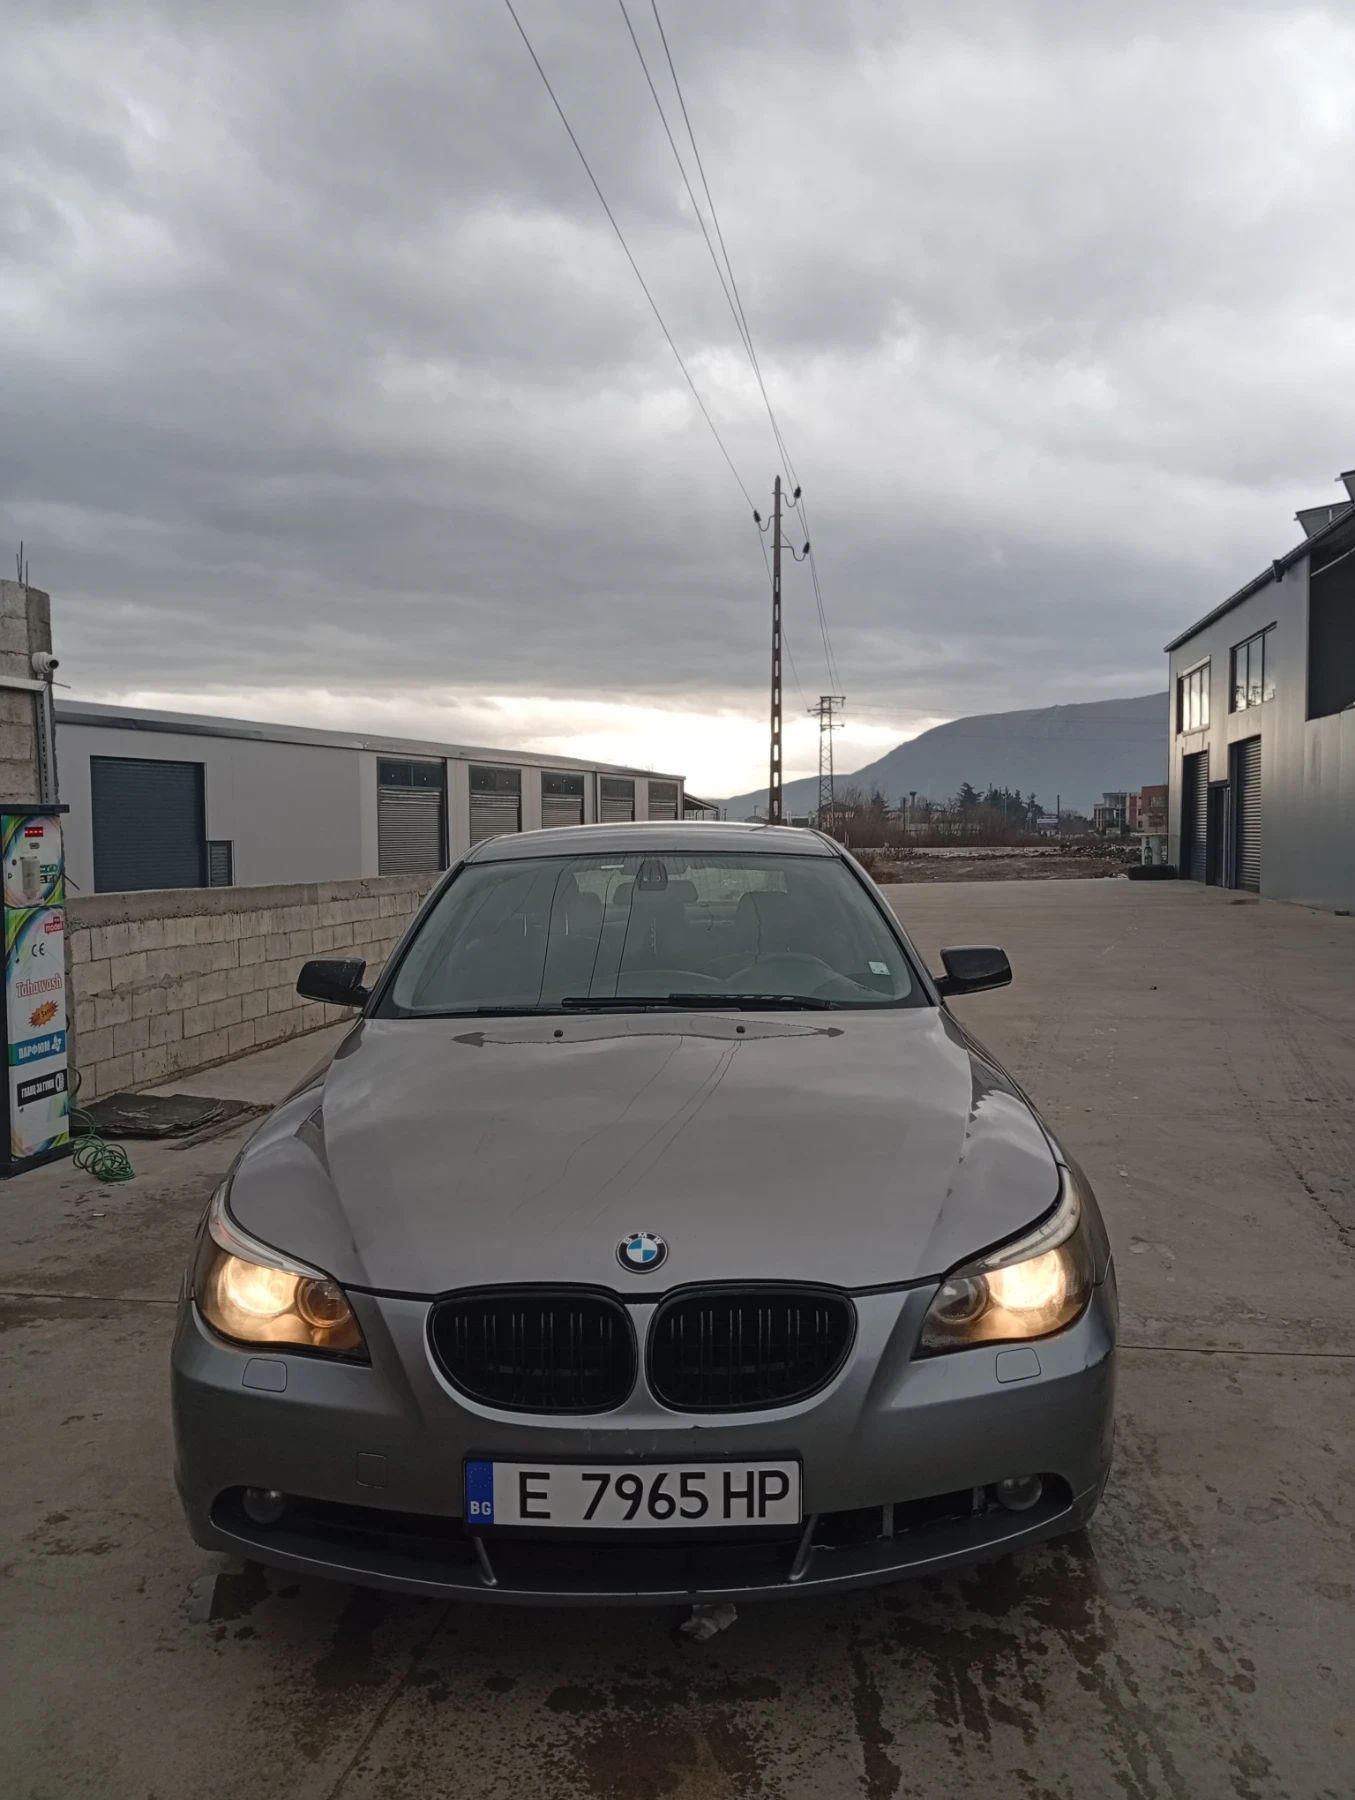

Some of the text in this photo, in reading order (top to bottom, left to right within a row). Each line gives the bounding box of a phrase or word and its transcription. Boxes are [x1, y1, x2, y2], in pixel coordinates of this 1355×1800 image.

[31, 942, 45, 957] CE
[16, 973, 62, 998] Tahawash
[18, 1040, 50, 1059] ПАРФЮМ
[622, 1231, 663, 1245] BMW
[518, 1469, 790, 1520] E 7965 HP
[470, 1501, 492, 1516] BG
